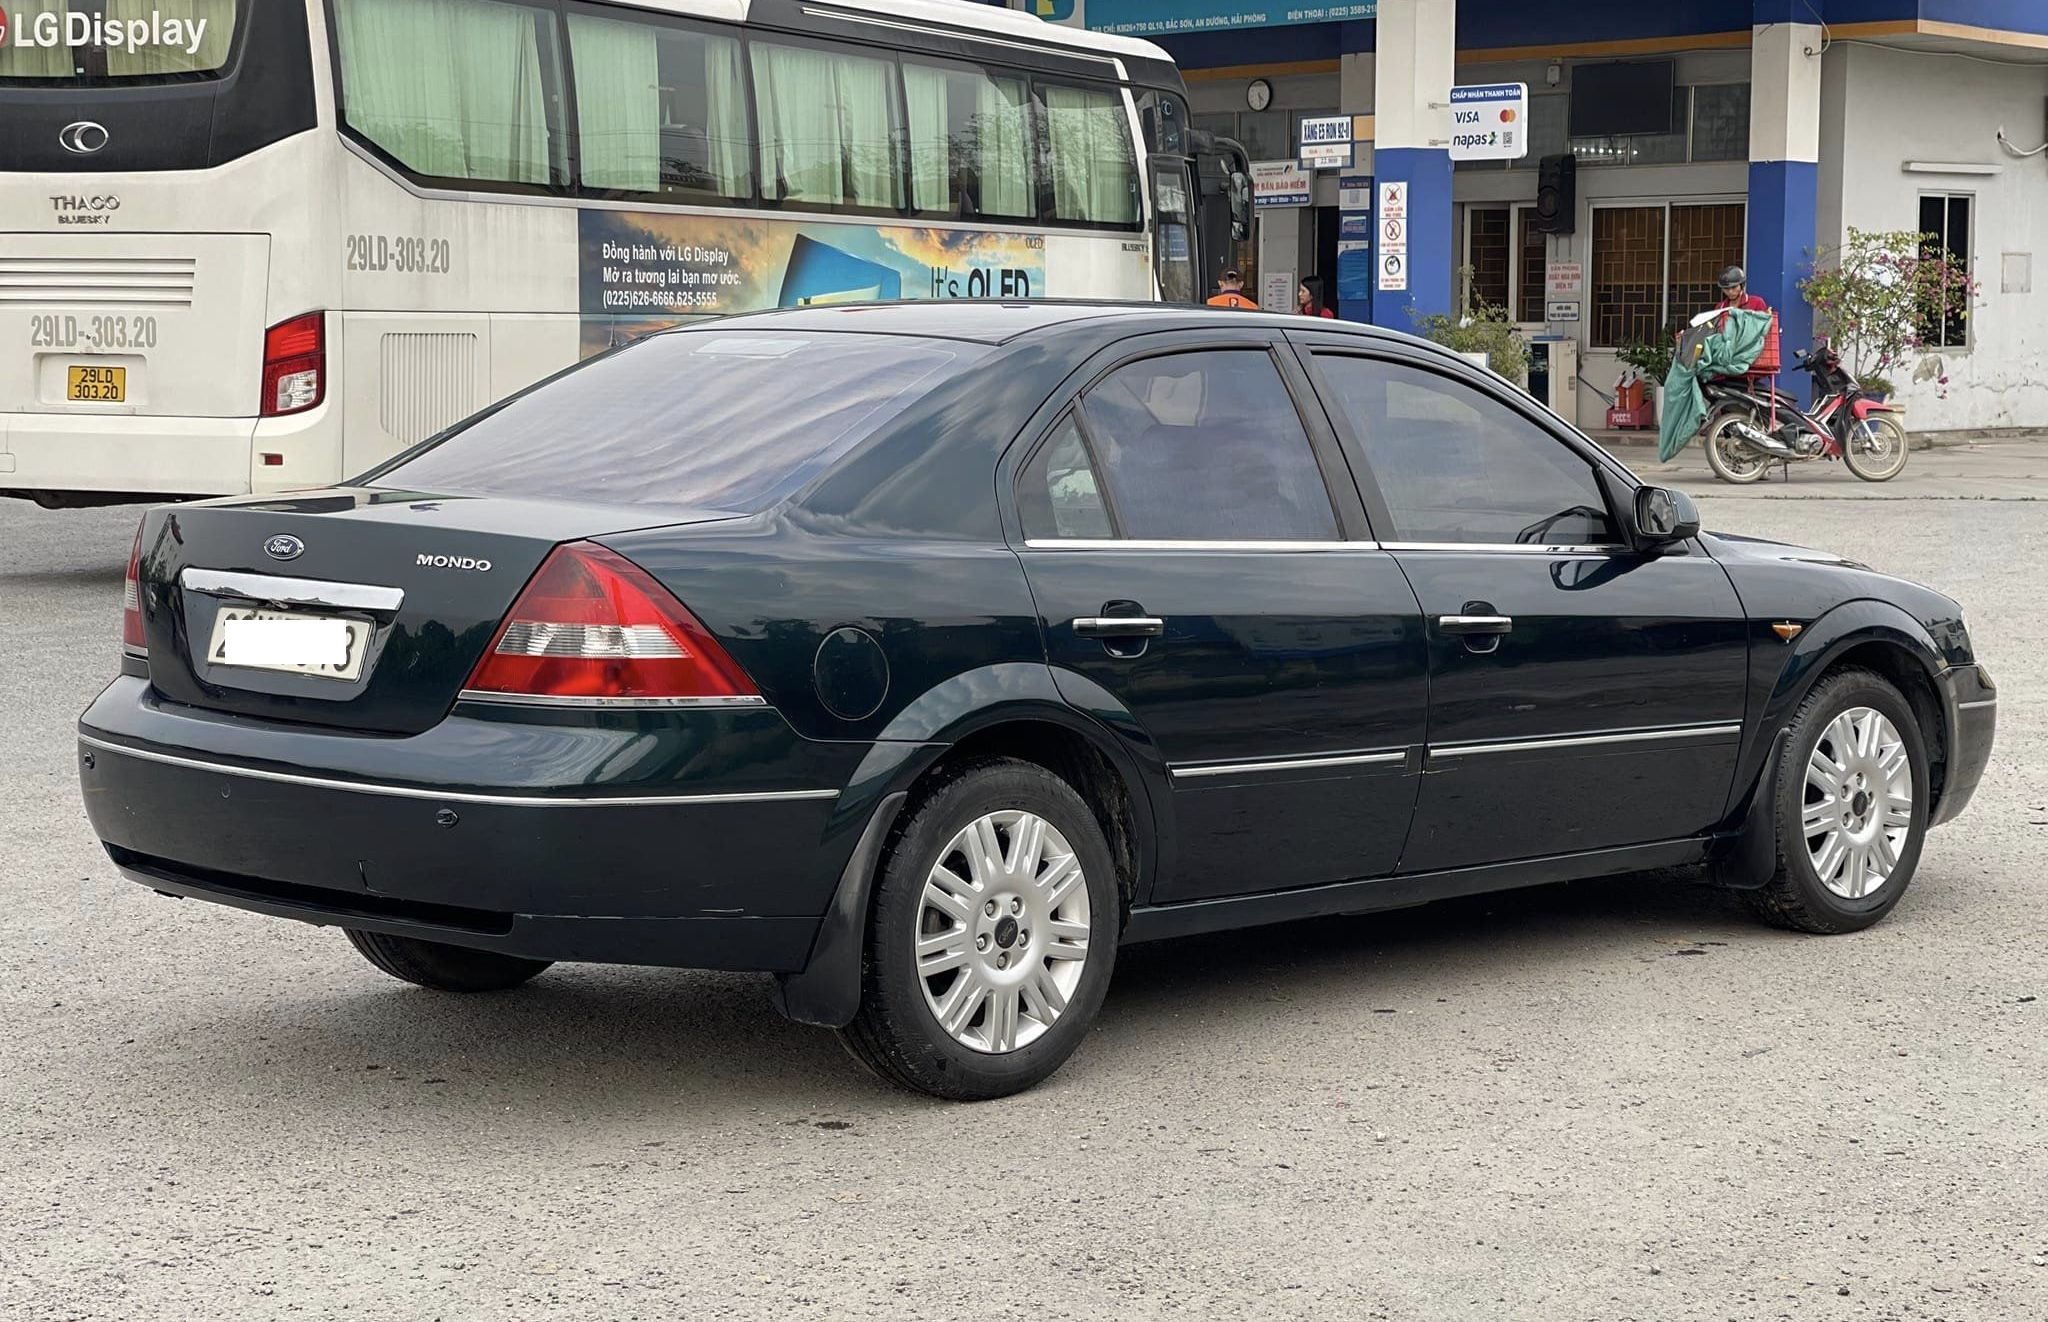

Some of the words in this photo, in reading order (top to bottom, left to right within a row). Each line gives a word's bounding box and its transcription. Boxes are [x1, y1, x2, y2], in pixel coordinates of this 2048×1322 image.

[1195, 18, 1205, 27] AN
[14, 12, 58, 47] LG
[66, 10, 207, 54] Display
[1452, 91, 1466, 99] CHẤP
[1485, 89, 1505, 98] THANH
[1505, 88, 1521, 97] TOÁN
[1455, 111, 1480, 123] VISA
[1453, 134, 1488, 149] napas
[49, 195, 120, 210] THACO
[347, 235, 450, 274] 29LD-303.20
[603, 240, 630, 263] Đồng
[632, 244, 657, 260] hành
[660, 245, 676, 261] với
[678, 246, 692, 261] LG
[694, 246, 729, 266] Display
[603, 266, 620, 283] Mở
[622, 270, 632, 283] ra
[635, 269, 666, 287] tương
[668, 269, 680, 284] lai
[682, 269, 700, 288] bạn
[702, 272, 719, 285] mơ
[31, 315, 157, 348] 29LD-303.20
[80, 369, 114, 384] 29LD
[74, 384, 119, 400] 303.20
[270, 538, 292, 554] Ford
[416, 554, 492, 572] MONDO
